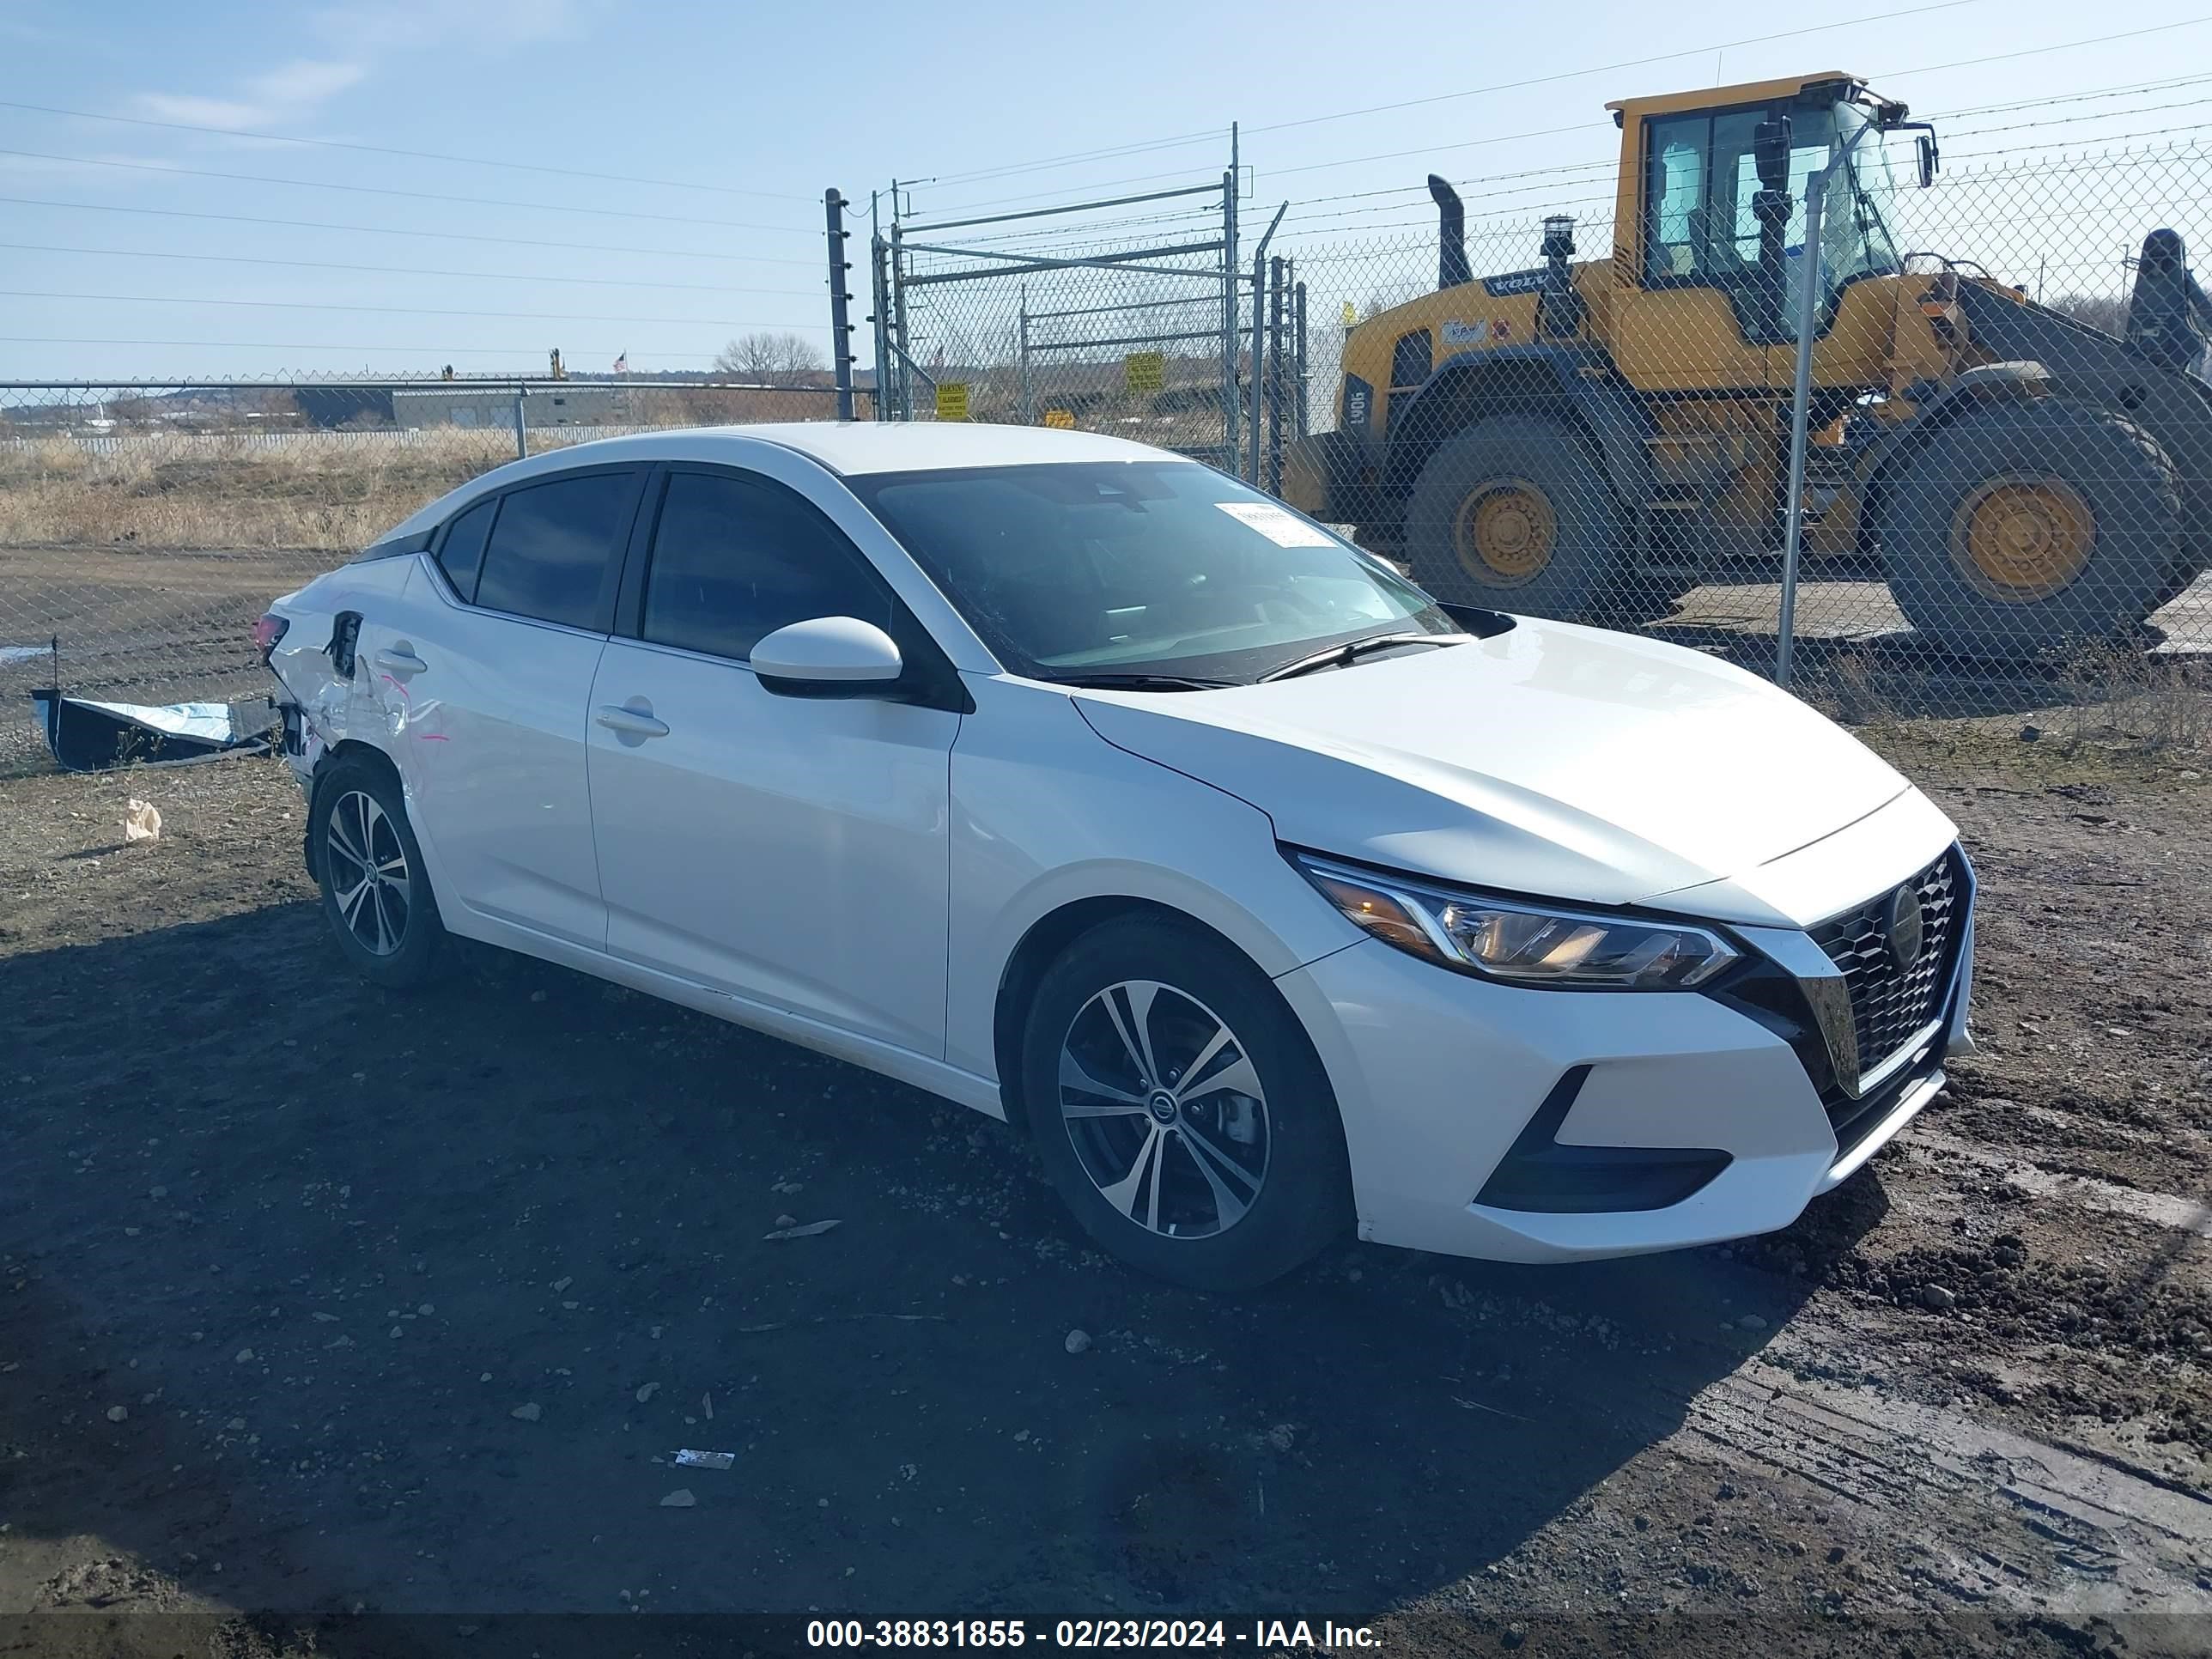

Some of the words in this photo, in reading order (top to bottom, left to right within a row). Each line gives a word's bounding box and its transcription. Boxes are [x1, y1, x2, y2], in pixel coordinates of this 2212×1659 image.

[1493, 274, 1549, 290] VOLV
[939, 384, 964, 392] WARNING
[1350, 392, 1365, 424] L90G
